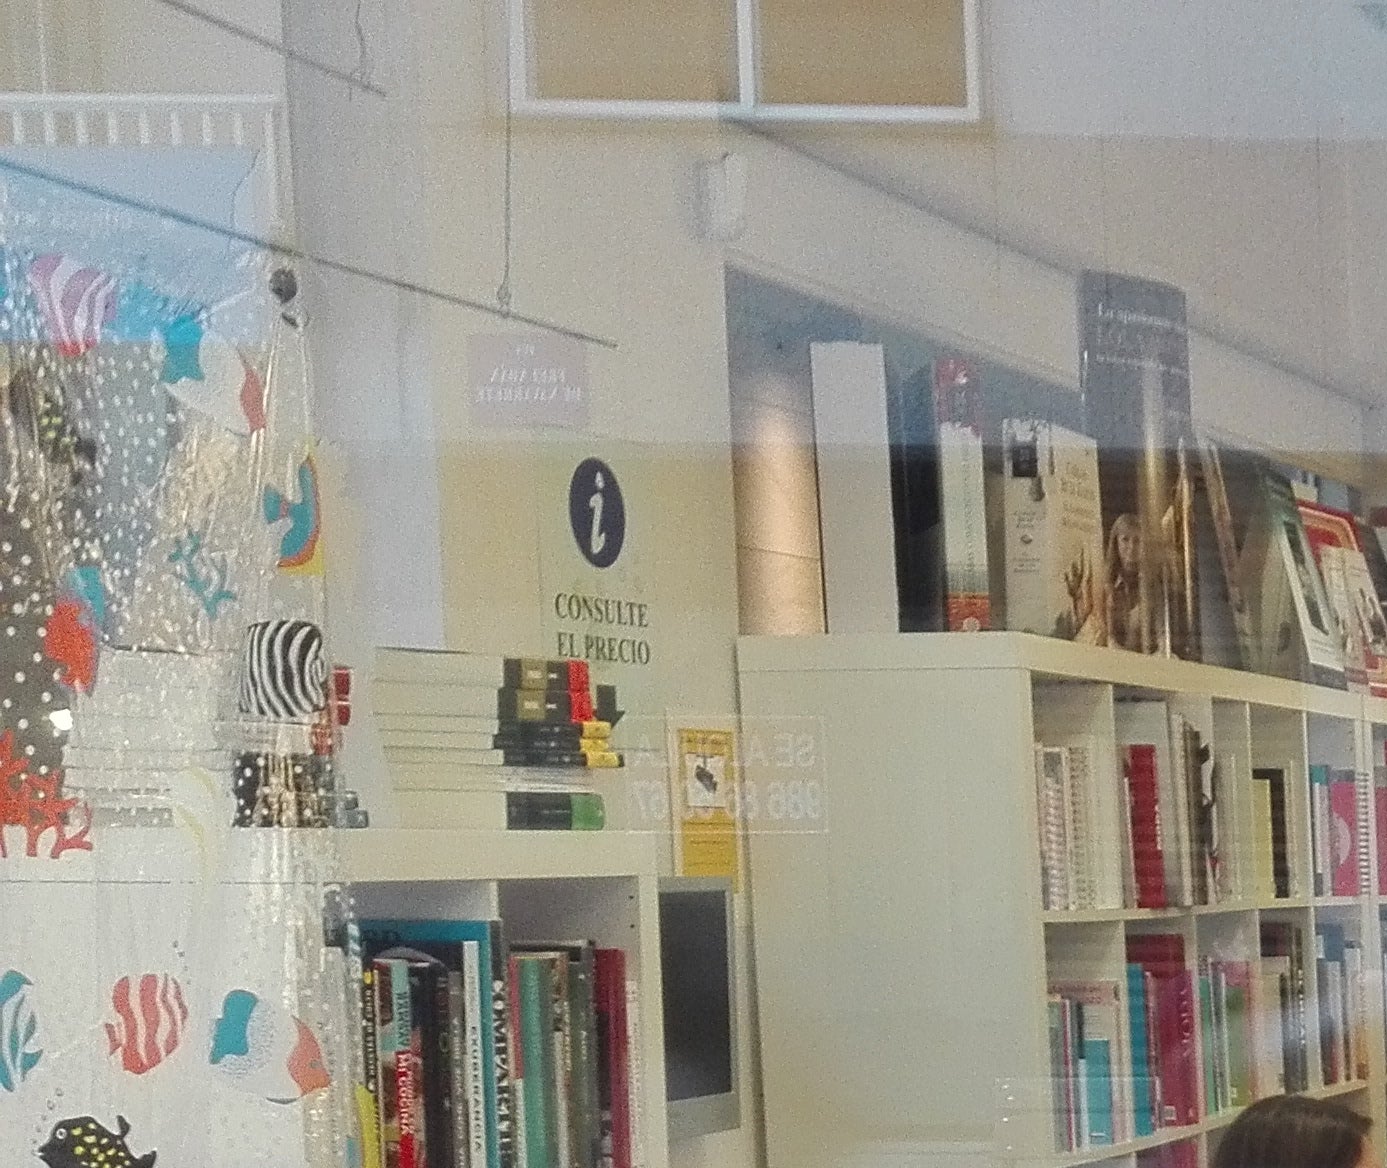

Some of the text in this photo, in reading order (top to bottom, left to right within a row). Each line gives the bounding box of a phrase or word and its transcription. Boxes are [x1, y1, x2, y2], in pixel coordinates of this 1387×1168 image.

[554, 592, 650, 628] CONSULTE
[556, 632, 651, 665] EL PRECIO
